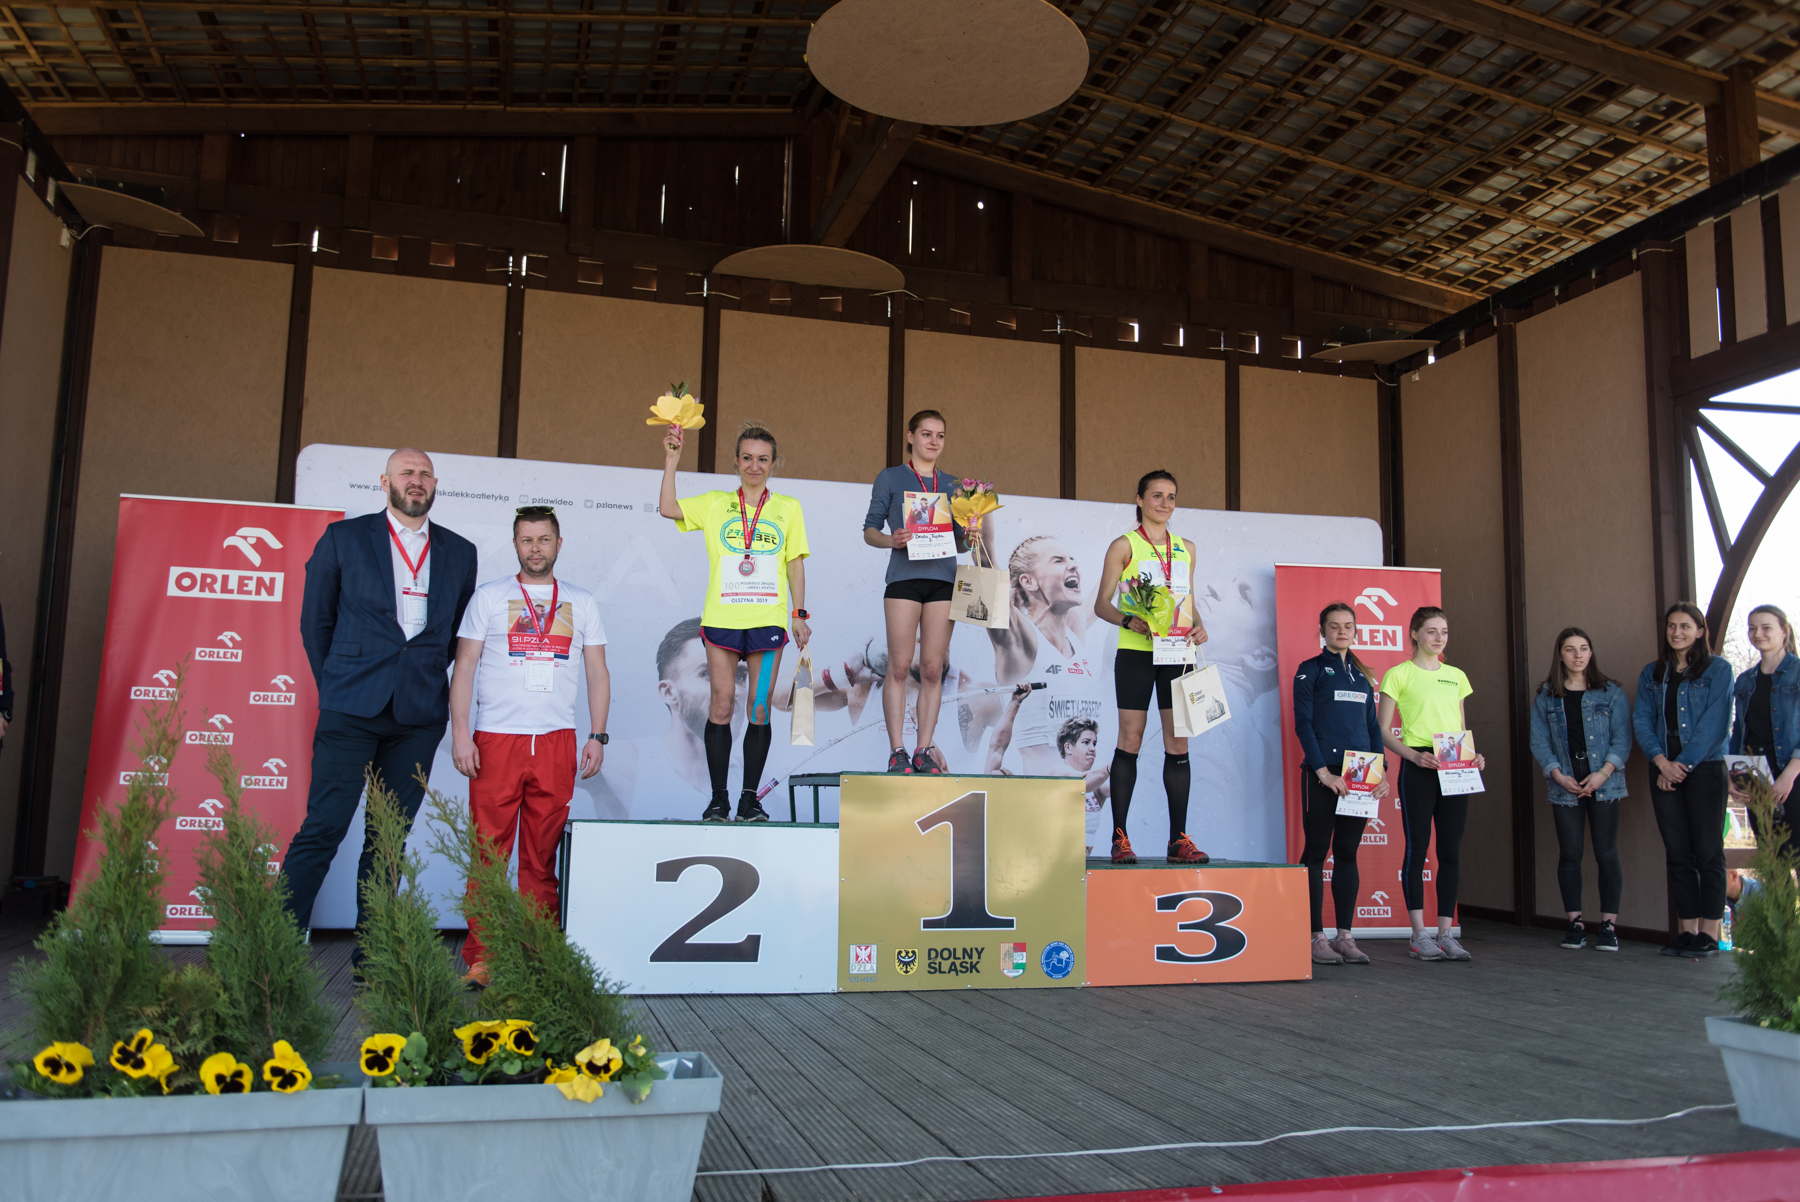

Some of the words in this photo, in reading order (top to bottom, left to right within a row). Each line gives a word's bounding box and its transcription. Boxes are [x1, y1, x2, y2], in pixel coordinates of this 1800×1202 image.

[349, 483, 383, 492] www.pz
[436, 489, 509, 502] lskalekkoatletyka
[531, 496, 574, 506] pzlawideo
[596, 501, 633, 511] pzlanews
[175, 571, 277, 597] ORLEN
[1350, 628, 1398, 647] LEN
[198, 650, 239, 660] ORLEN
[1045, 664, 1062, 675] 4F
[133, 688, 175, 699] ORLEN
[252, 693, 293, 703] ORLEN
[188, 732, 231, 743] ORLEN
[243, 778, 285, 787] ORLEN
[178, 818, 222, 828] ORLEN
[1361, 835, 1386, 843] RLEN
[915, 790, 1016, 931] 1
[649, 854, 763, 964] 2
[1359, 908, 1389, 916] ORLEN
[1155, 890, 1248, 964] 3
[927, 947, 985, 961] DOLNY
[851, 963, 876, 973] PZLA
[927, 957, 981, 976] ŚLĄSK
